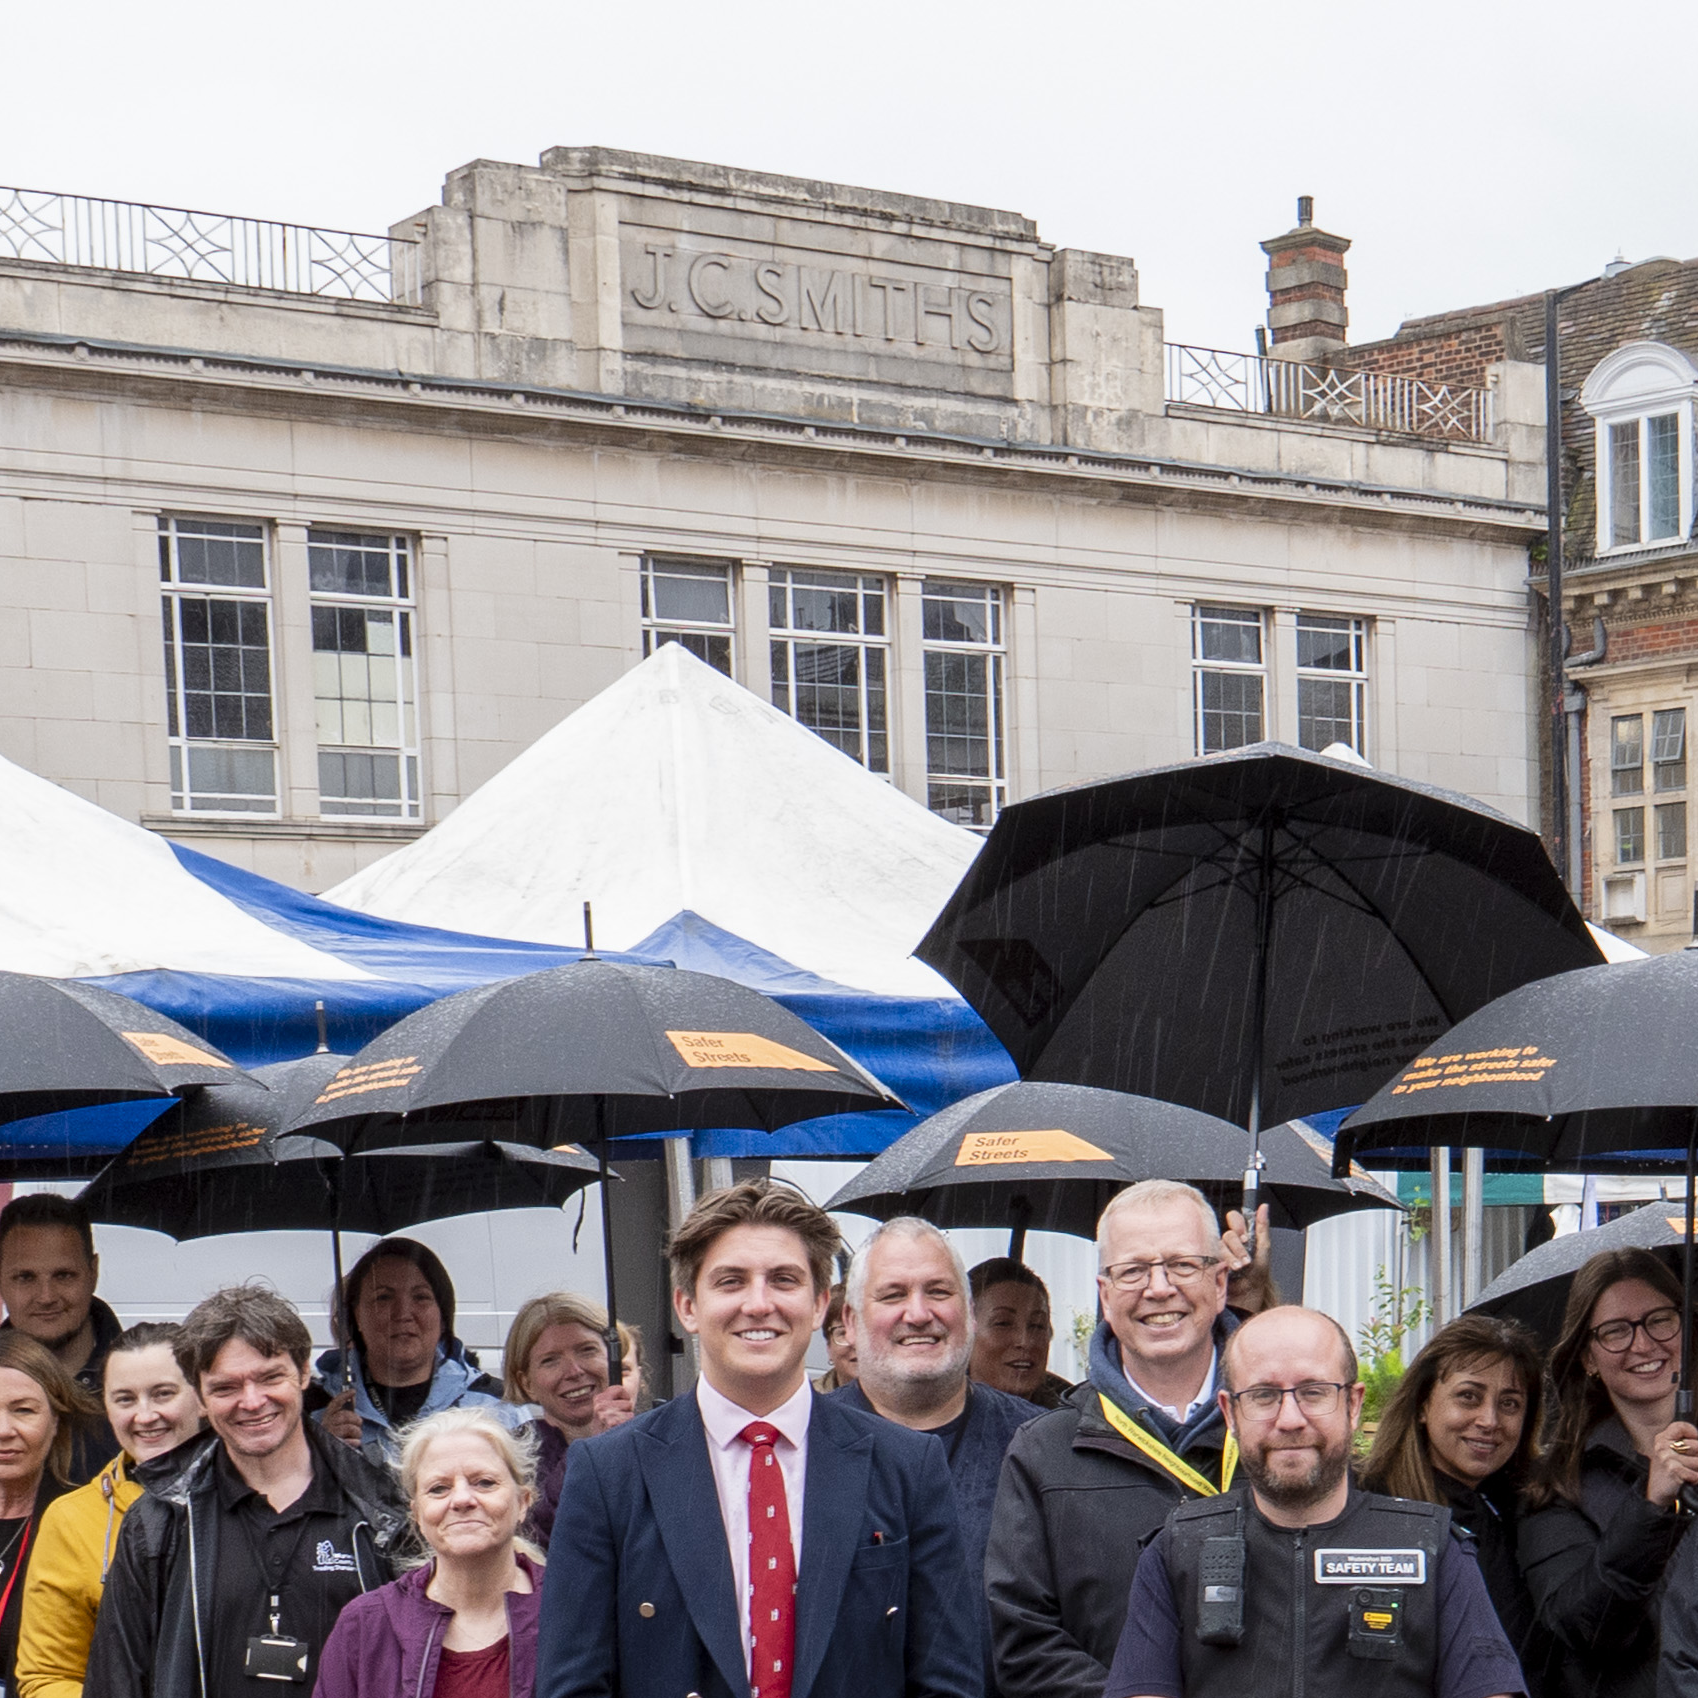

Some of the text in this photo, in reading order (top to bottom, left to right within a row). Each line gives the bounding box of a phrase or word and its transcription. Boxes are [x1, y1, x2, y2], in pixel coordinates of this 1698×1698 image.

[681, 1036, 725, 1048] Safer
[692, 1051, 752, 1063] Streets
[1437, 1054, 1463, 1064] are
[1464, 1047, 1521, 1061] working
[1521, 1045, 1539, 1055] to
[1402, 1057, 1558, 1082] make the streets safer
[1392, 1070, 1545, 1095] in your neighbourhood
[974, 1136, 1021, 1148] Safer
[969, 1149, 1030, 1161] Streets
[1326, 1562, 1414, 1574] SAFETY TEAM
